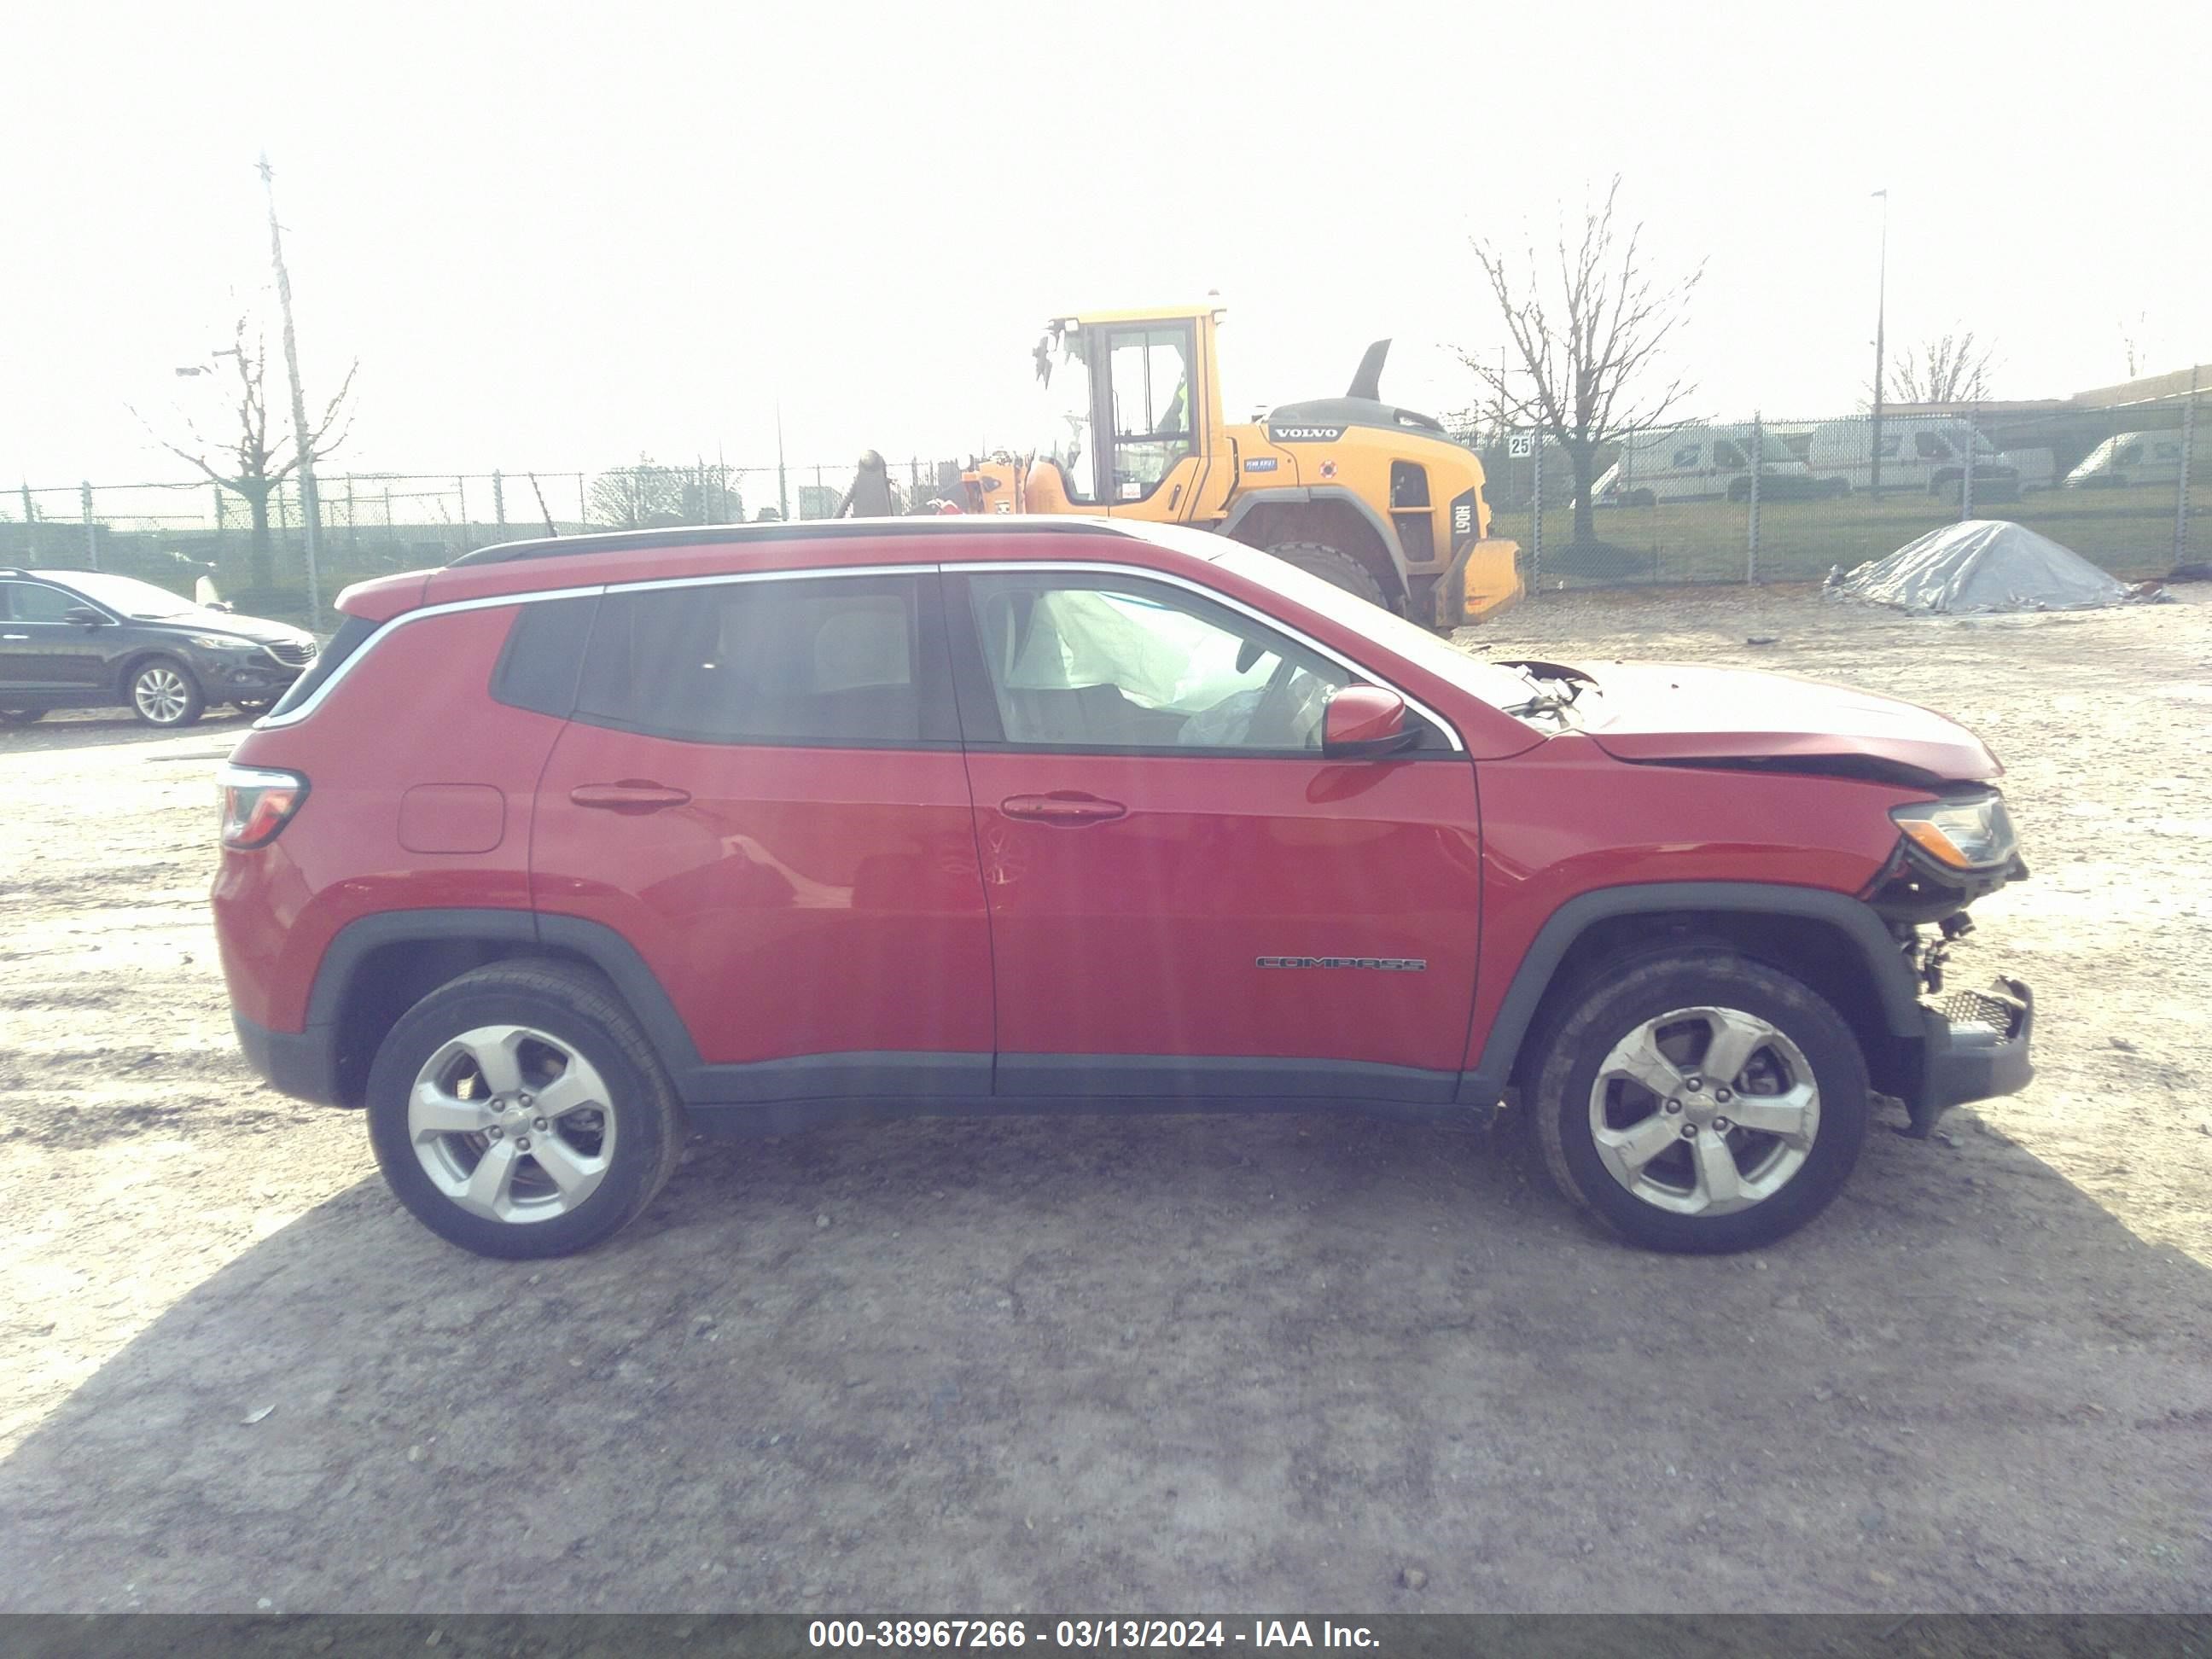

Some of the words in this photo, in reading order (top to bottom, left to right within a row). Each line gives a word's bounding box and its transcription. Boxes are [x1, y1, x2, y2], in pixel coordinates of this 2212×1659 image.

[1275, 428, 1338, 438] VOLVO
[1511, 438, 1529, 454] 25
[1455, 505, 1471, 534] L90H
[1256, 956, 1427, 971] COMPASS
